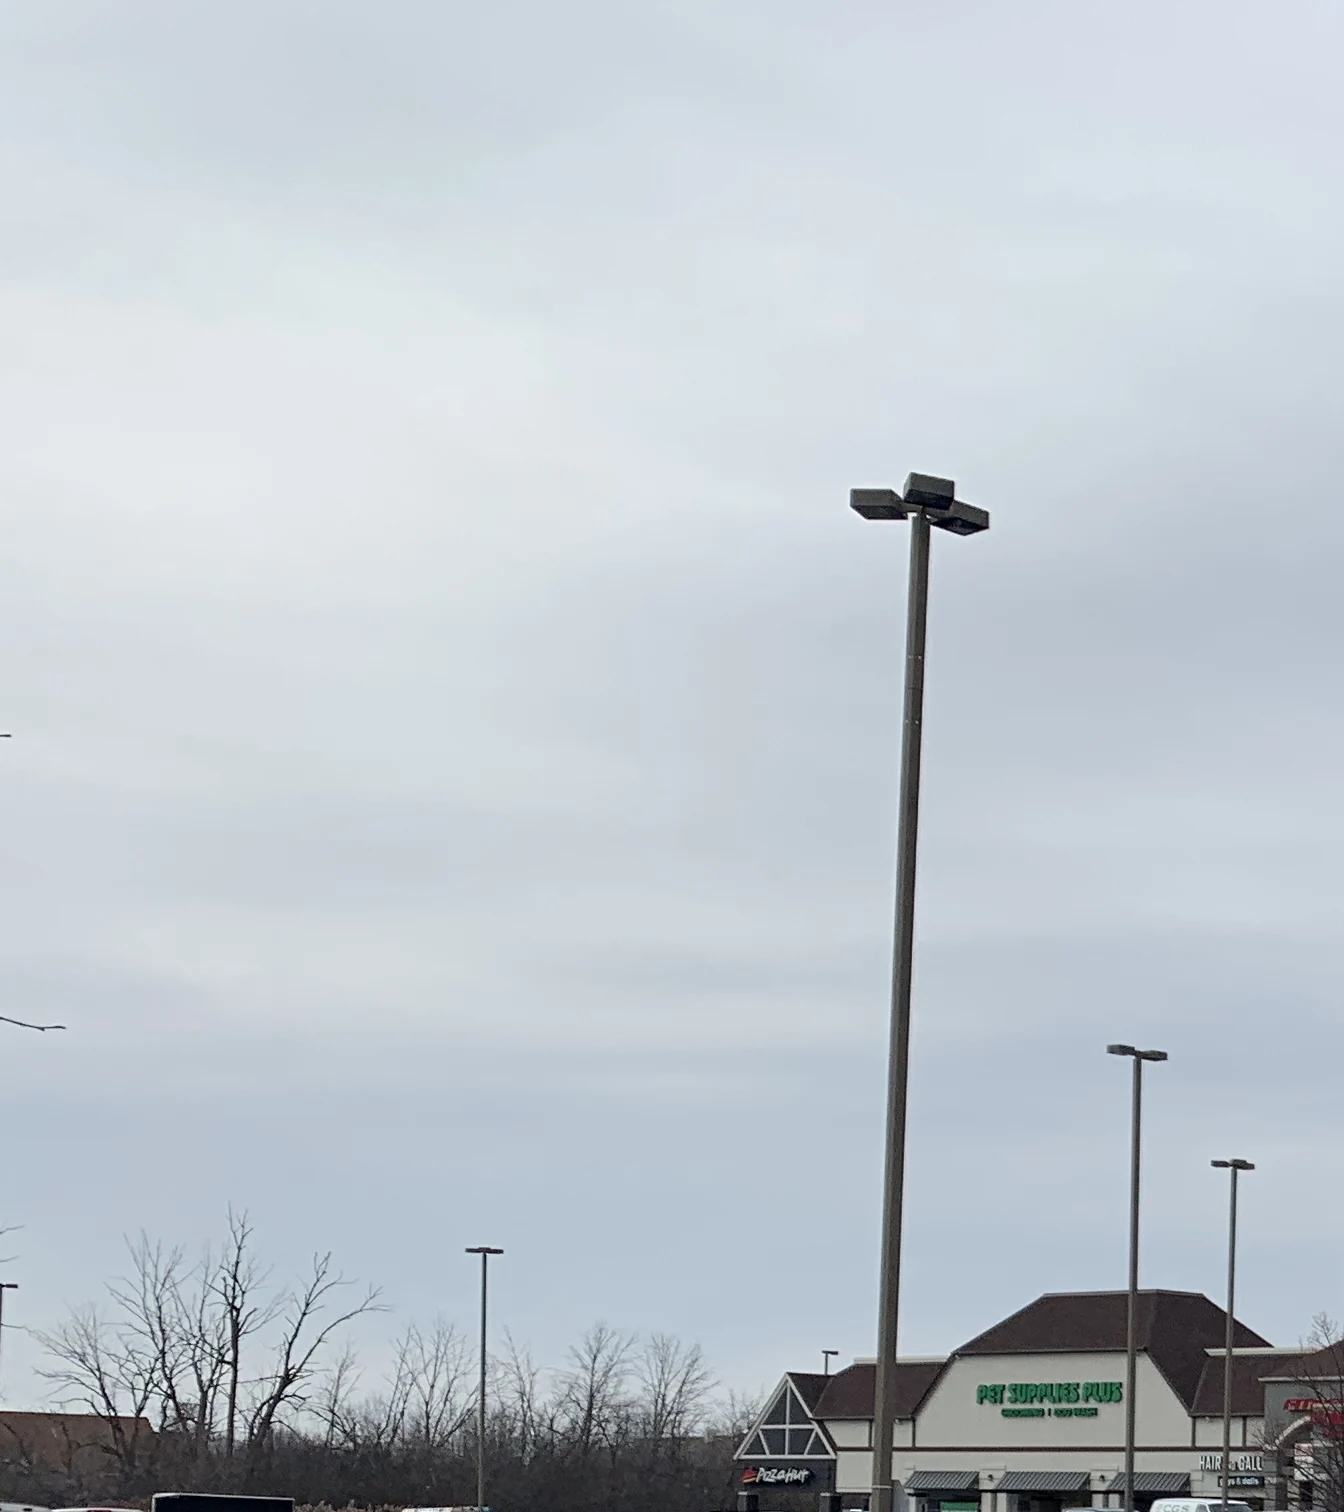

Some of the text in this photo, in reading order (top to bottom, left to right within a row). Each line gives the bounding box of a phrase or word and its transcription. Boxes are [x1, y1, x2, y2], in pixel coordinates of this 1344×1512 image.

[976, 1382, 1123, 1405] PET SUPPLIES PLUS
[1200, 1456, 1221, 1470] HAIR
